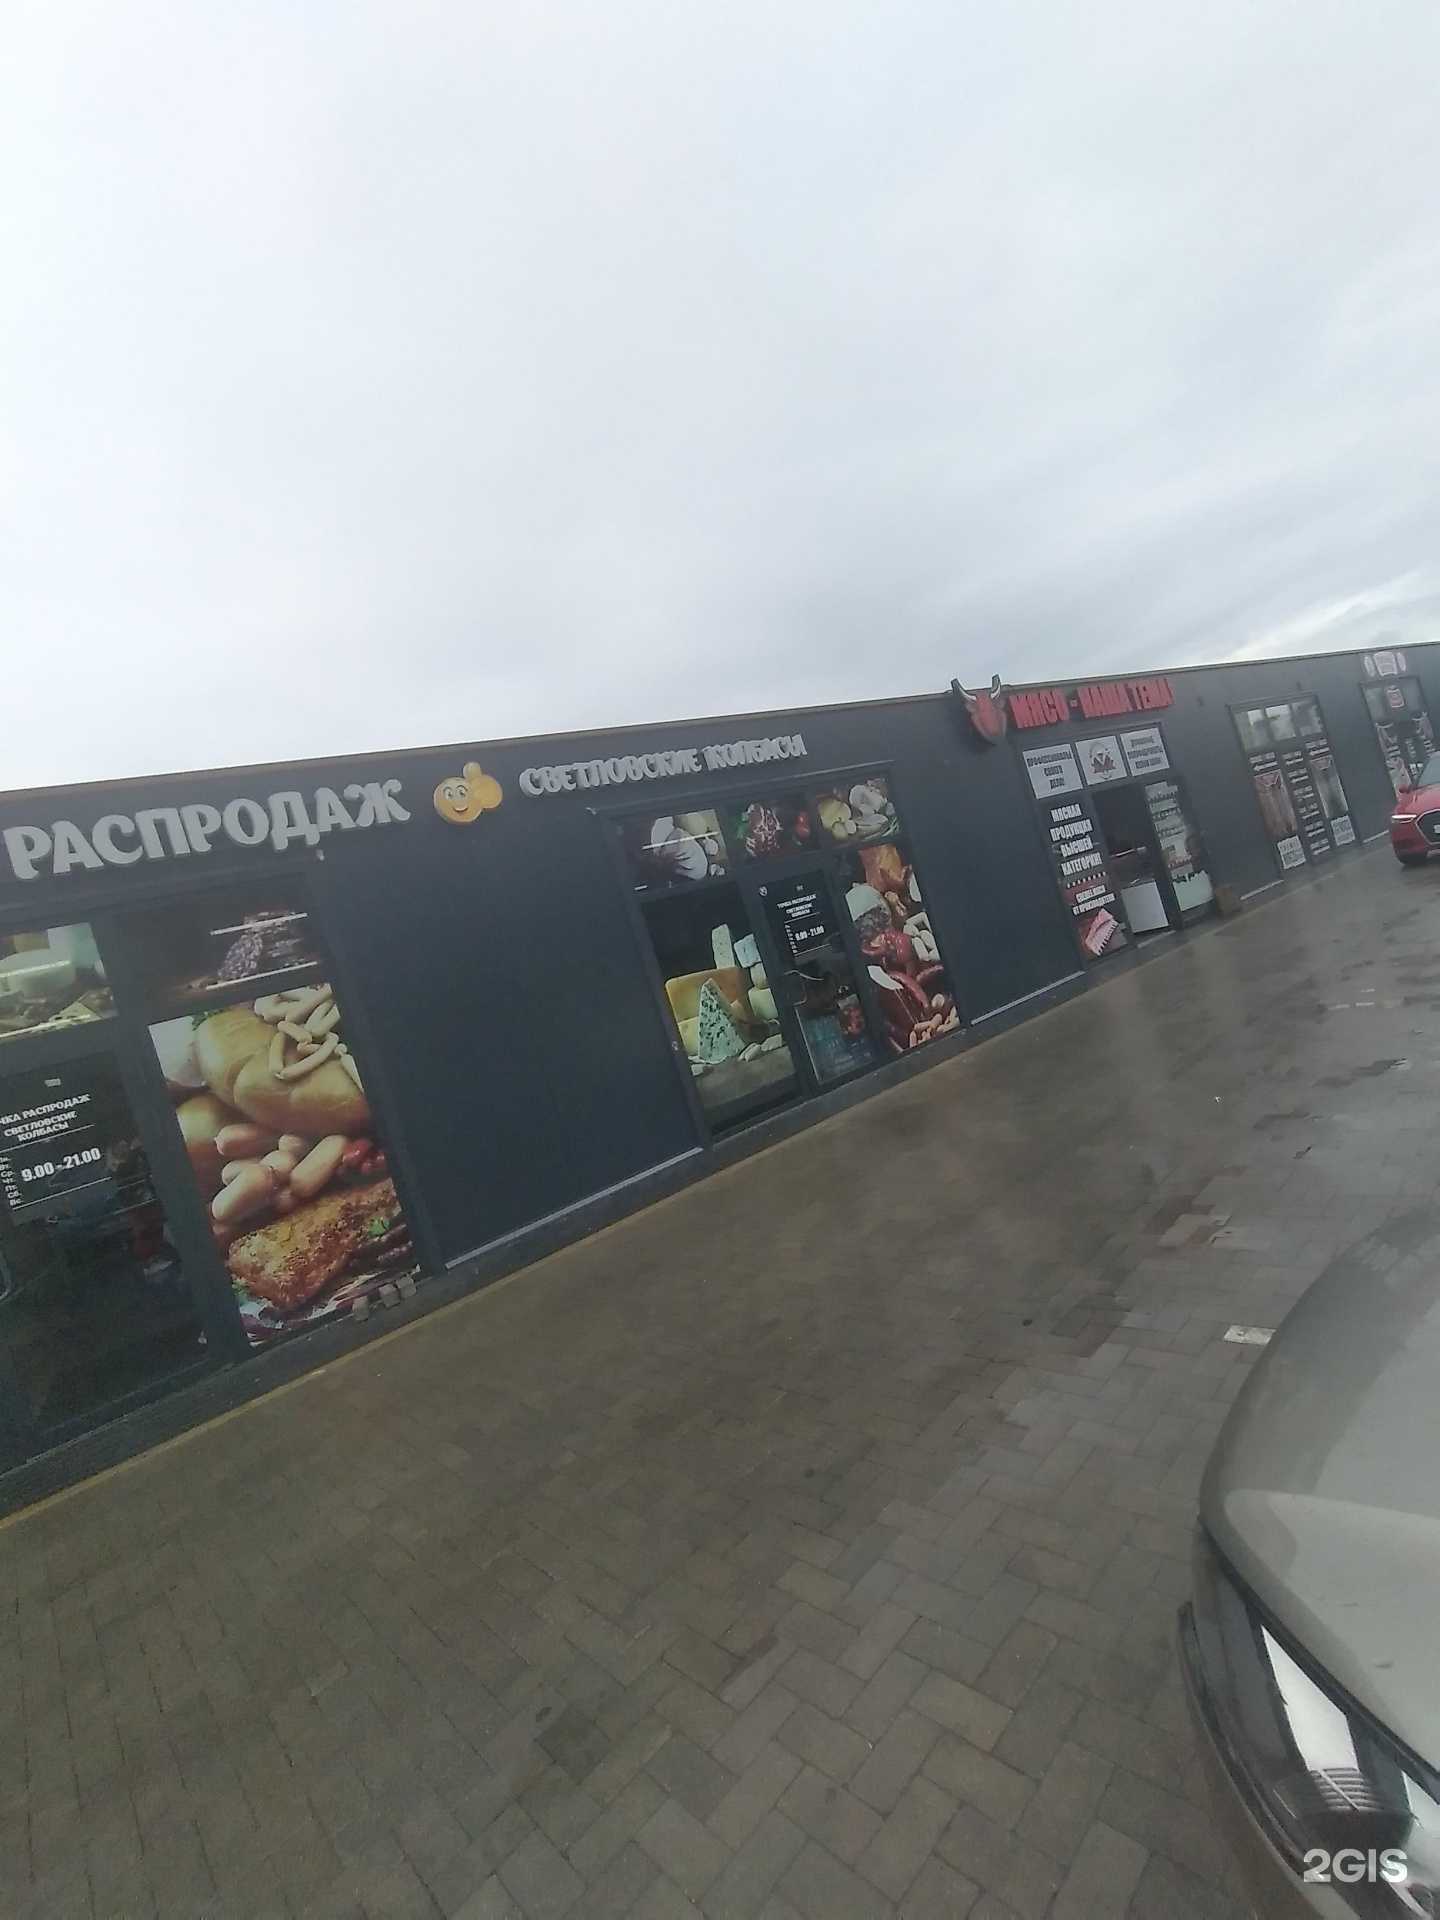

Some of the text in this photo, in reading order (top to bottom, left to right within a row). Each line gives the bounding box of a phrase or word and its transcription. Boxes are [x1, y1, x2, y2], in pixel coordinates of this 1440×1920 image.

[519, 734, 808, 796] СВЕТЛОВСКИЕ КОЛБАСЫ
[1051, 804, 1082, 822] МЯСНАЯ
[2, 779, 411, 880] РАСПРОДАЖ
[1050, 819, 1093, 842] ПРОДУКЦИЯ
[1060, 834, 1094, 857] ВЫСШЕЙ
[1061, 852, 1103, 876] КАТЕГОРИИ
[22, 1093, 91, 1120] РАСПРОДАЖ
[4, 1110, 78, 1137] СВЕТЛОВСКИЕ
[17, 1121, 70, 1142] КОЛБАСЫ
